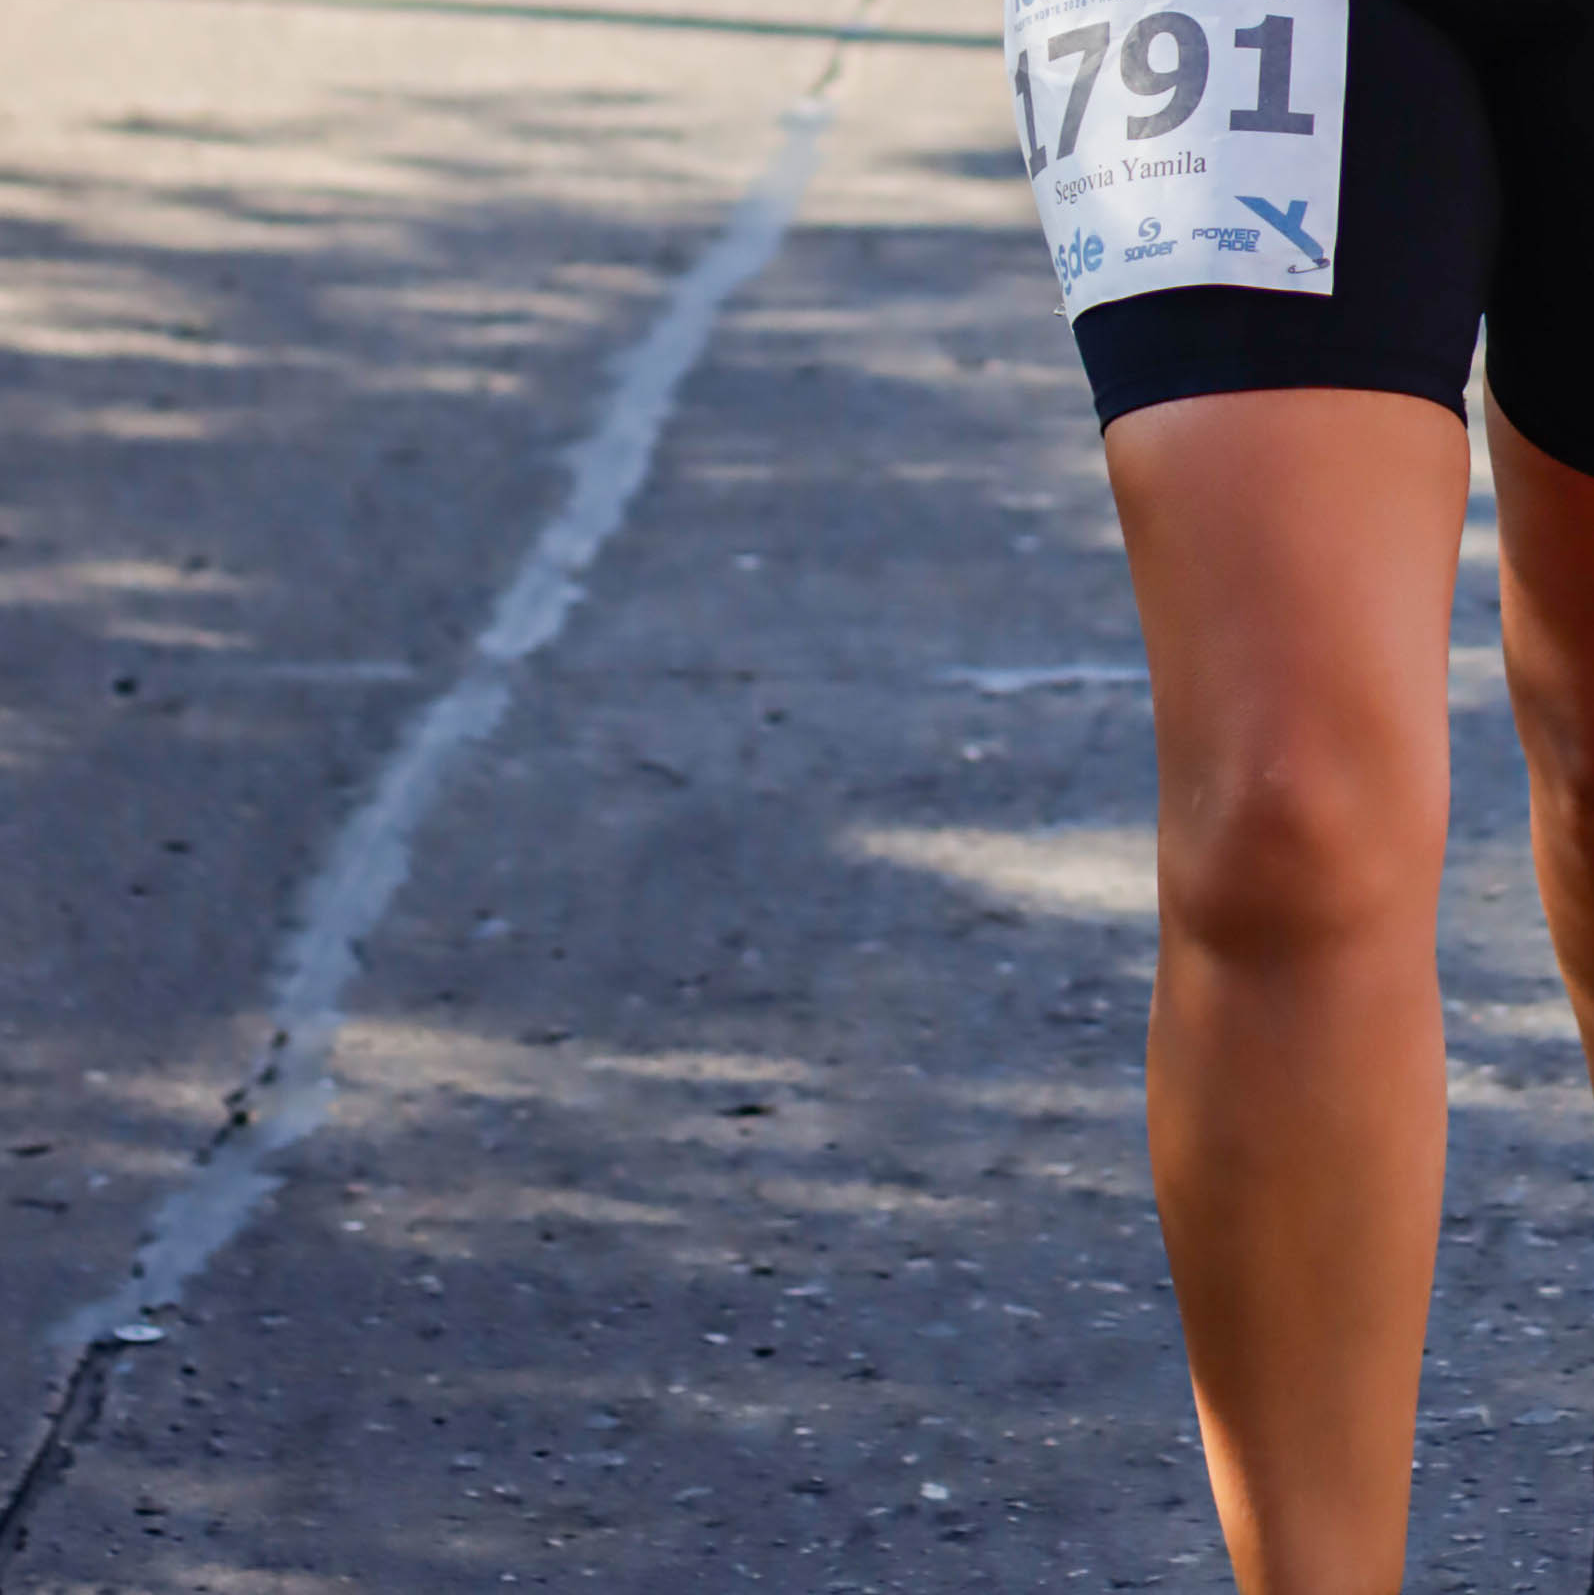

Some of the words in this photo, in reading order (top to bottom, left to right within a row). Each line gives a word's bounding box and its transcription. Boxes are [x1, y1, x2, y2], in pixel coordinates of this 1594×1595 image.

[1015, 11, 1315, 181] 1791
[1055, 164, 1114, 205] Segovia
[1121, 151, 1207, 183] Yamila
[1192, 227, 1261, 242] POWER
[1217, 239, 1260, 253] ADE
